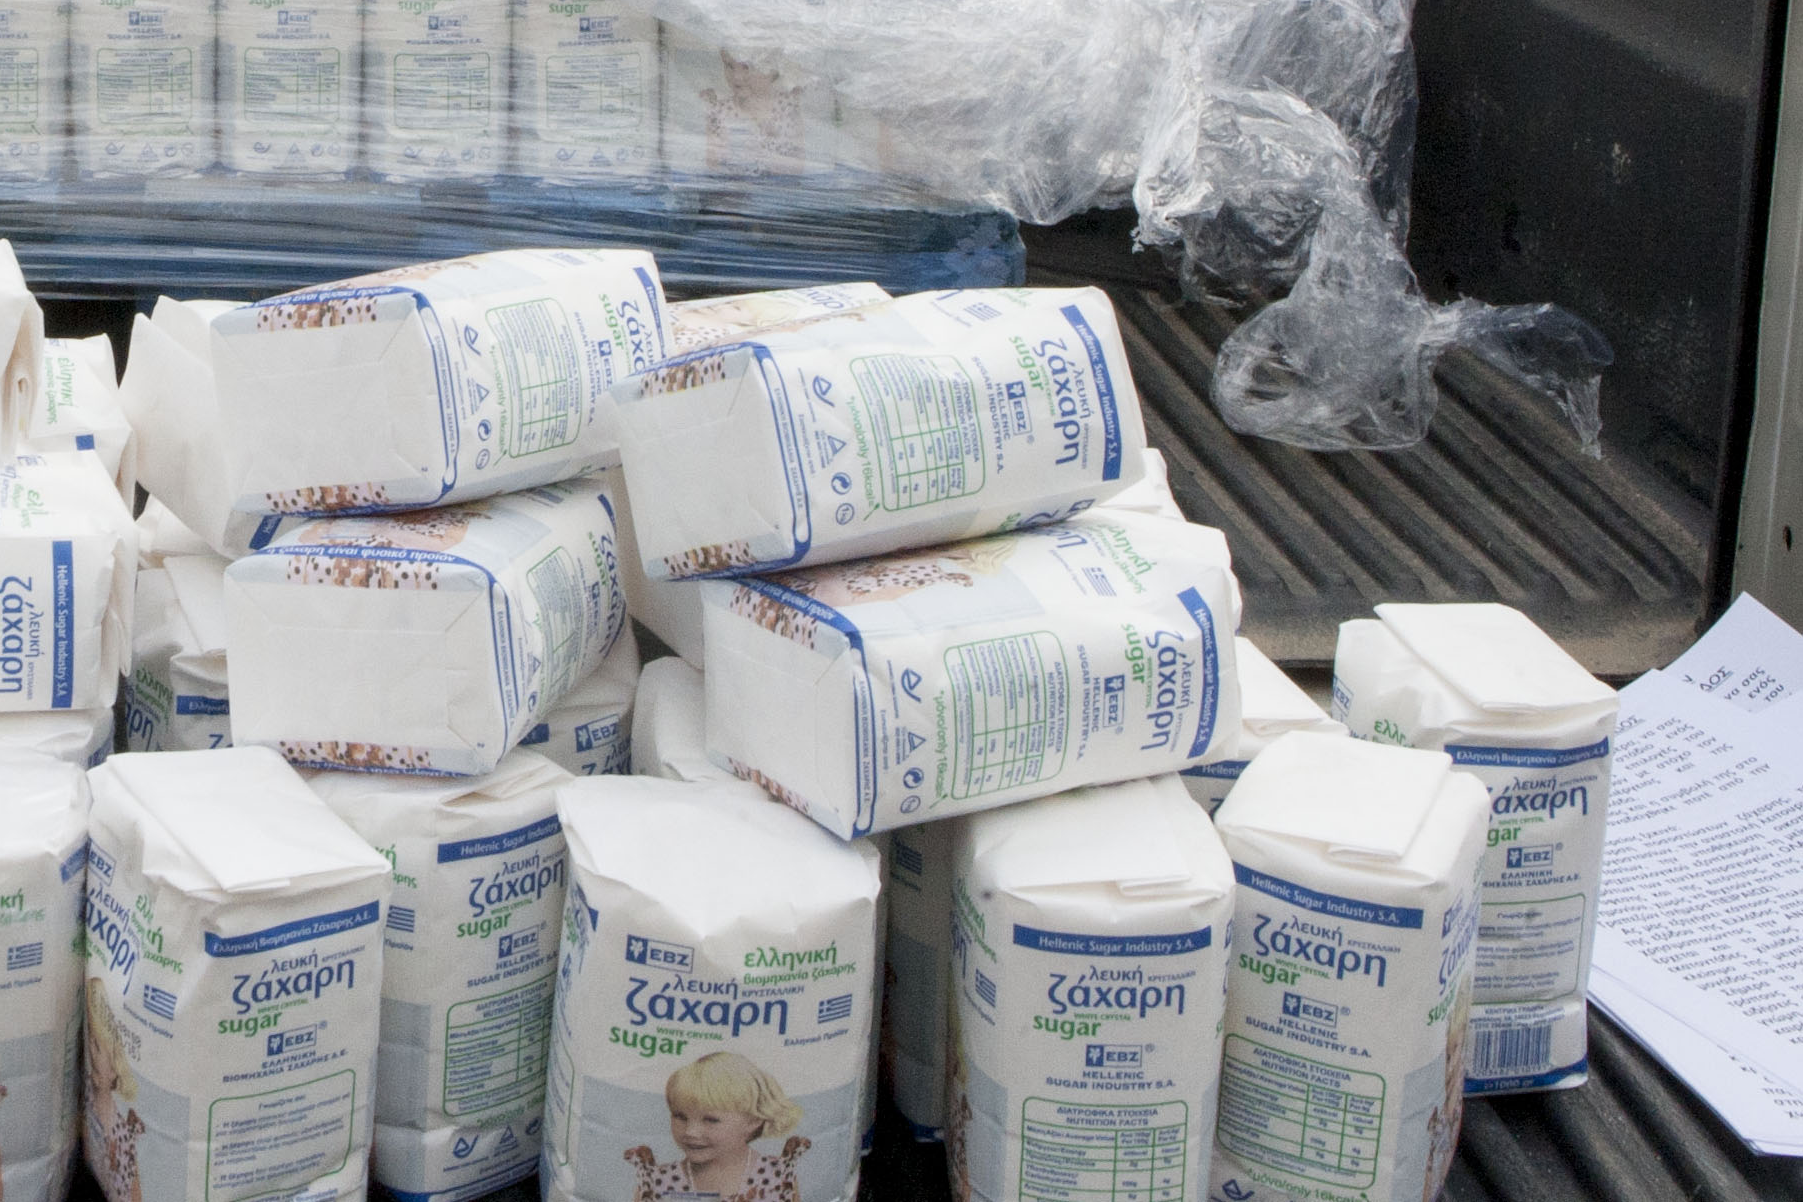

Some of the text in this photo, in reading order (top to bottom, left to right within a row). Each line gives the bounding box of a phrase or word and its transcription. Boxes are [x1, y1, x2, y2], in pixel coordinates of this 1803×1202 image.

[598, 293, 625, 350] sugar
[1009, 335, 1044, 391] sugar
[1033, 338, 1082, 465] ζάχαρη
[25, 611, 45, 658] λευκή
[1121, 623, 1146, 684] sugar
[1141, 630, 1185, 752] ζάχαρη
[1741, 666, 1766, 687] σας
[1748, 676, 1776, 699] ενός
[1763, 684, 1784, 703] του
[1487, 784, 1588, 822] άχαρη
[460, 832, 527, 858] Hellenic Sugar
[470, 859, 565, 917] ζάχαρη
[1251, 873, 1376, 923] Hellenic Sugar Industry
[457, 910, 513, 939] sugar
[213, 936, 260, 956] Ελληνική
[744, 941, 838, 971] ελληνική
[1039, 935, 1085, 952] Hellenic
[1089, 938, 1122, 955] Sugar
[1125, 939, 1173, 954] Industry
[1253, 913, 1388, 987] ζάχαρη
[271, 948, 319, 974] λευκή
[743, 961, 857, 988] βιομηχανία ζάχαρης
[1089, 966, 1144, 984] λευκή
[1238, 953, 1302, 988] sugar
[232, 957, 356, 1015] ζάχαρη
[673, 973, 739, 1000] λευκή
[1047, 973, 1186, 1018] ζάχαρη
[625, 976, 788, 1037] ζάχαρη
[217, 1009, 284, 1039] sugar
[1032, 1014, 1101, 1041] sugar
[1278, 1015, 1339, 1042] HELLENIC
[608, 1025, 688, 1058] sugar
[1045, 1077, 1153, 1091] SUGAR INDUSTRY
[1082, 1070, 1144, 1080] HELLENIC
[1118, 1118, 1149, 1127] FACTS
